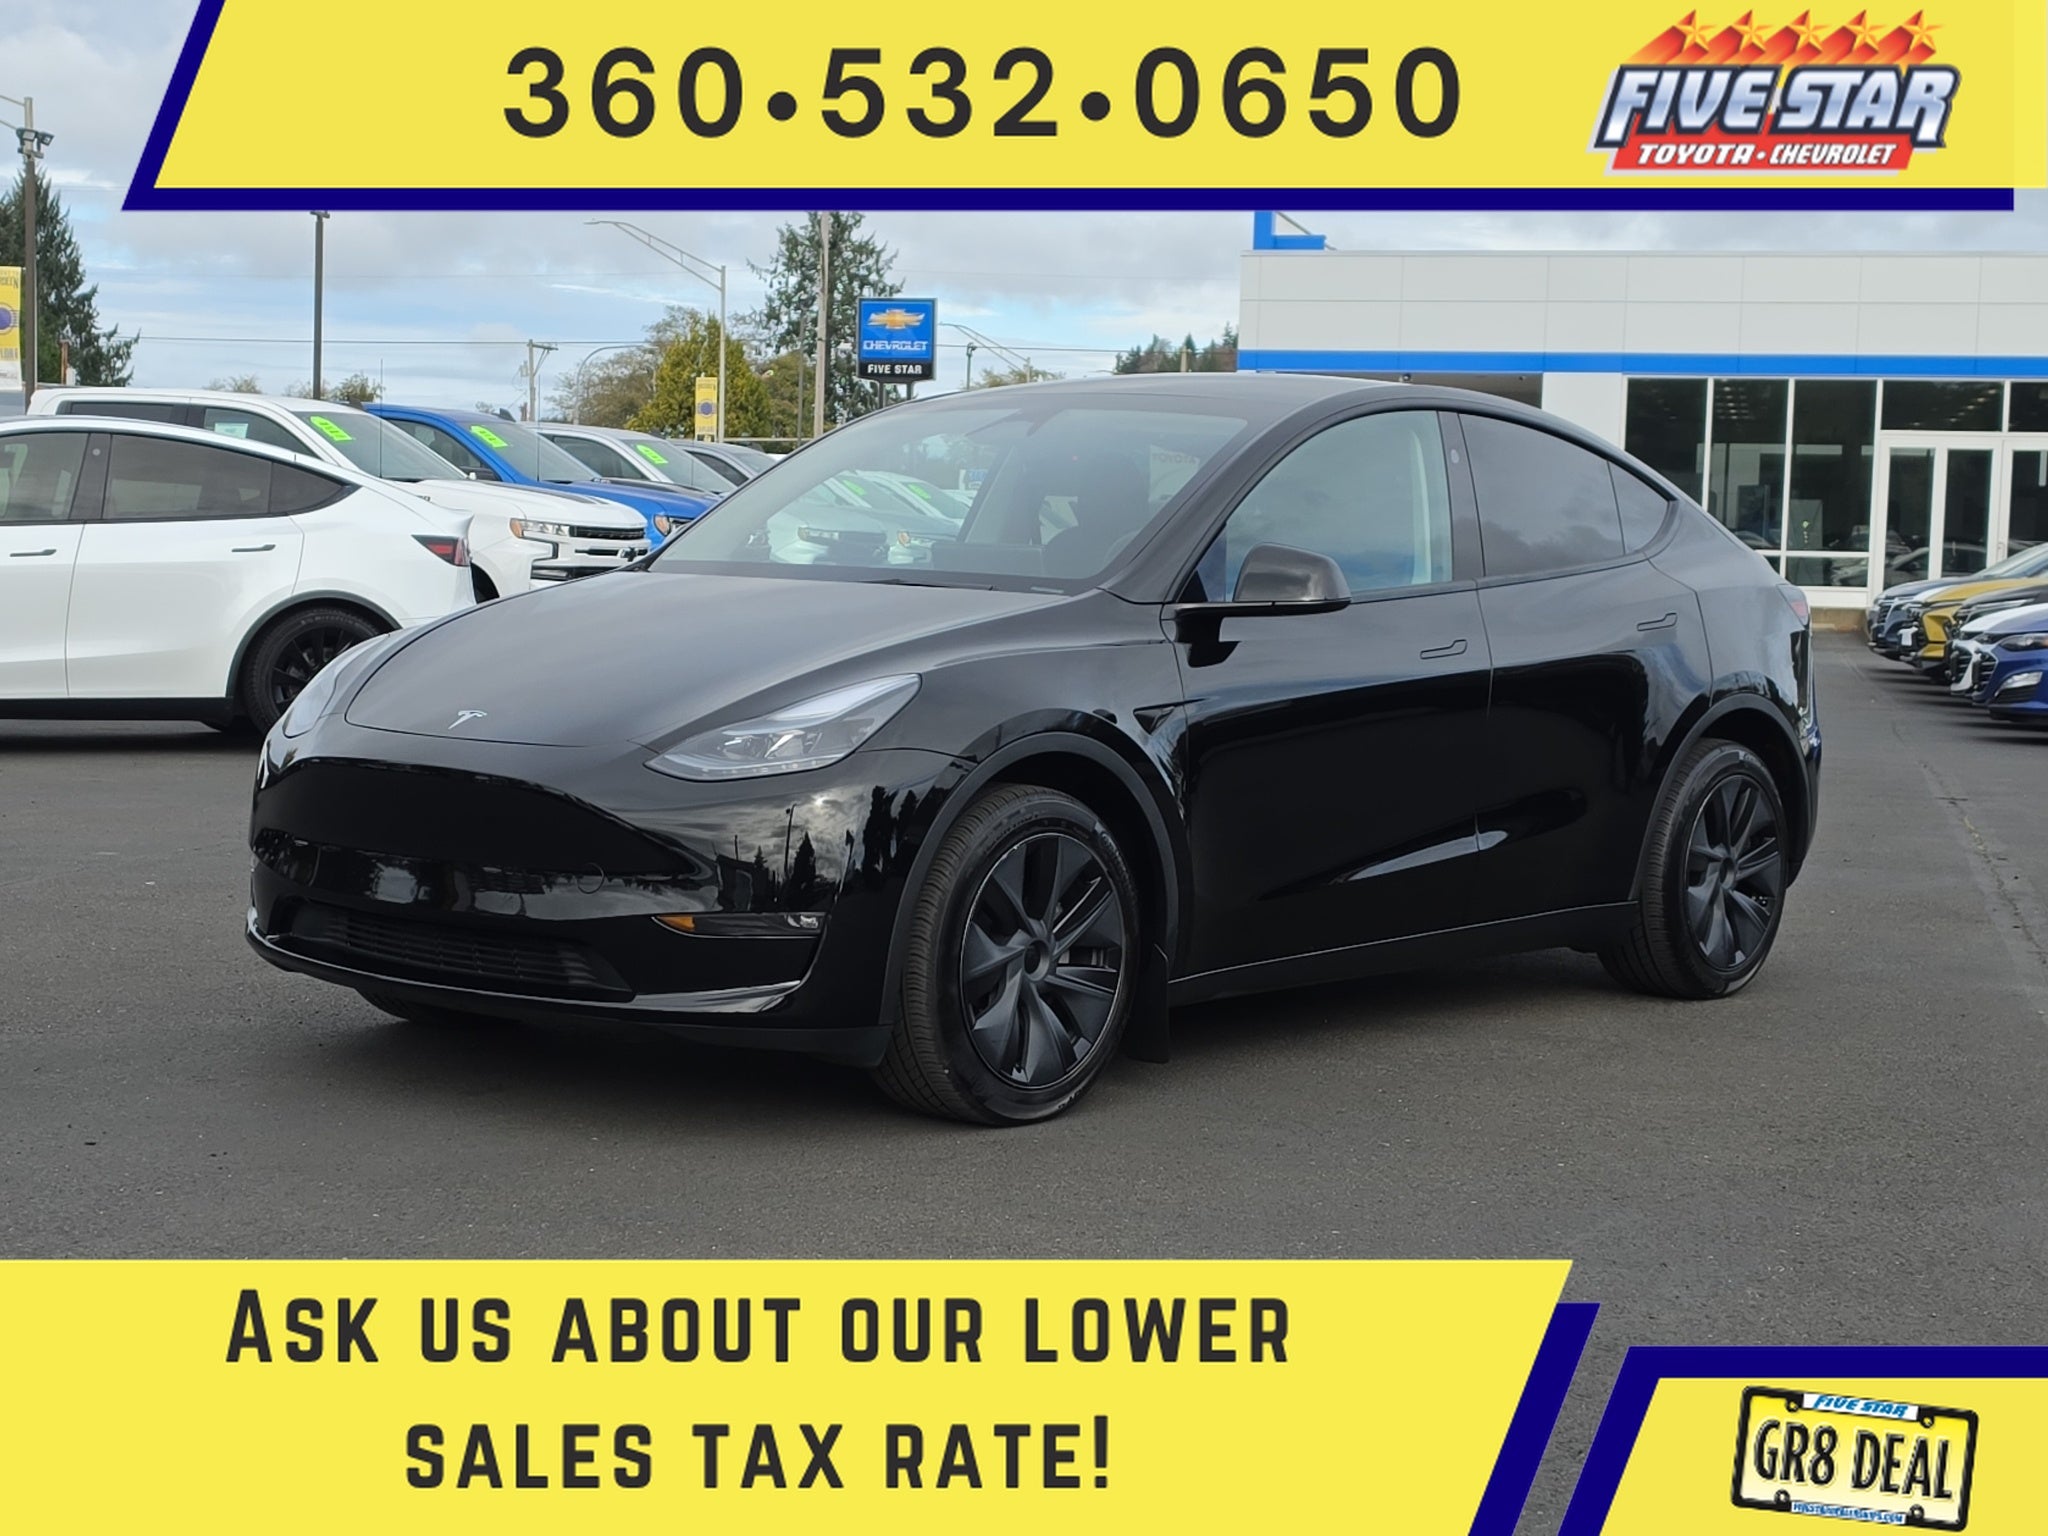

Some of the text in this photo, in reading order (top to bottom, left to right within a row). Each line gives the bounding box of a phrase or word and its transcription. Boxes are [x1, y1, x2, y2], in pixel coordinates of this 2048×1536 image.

[862, 340, 929, 351] CHEVROLET
[867, 363, 923, 374] FIVE STAR
